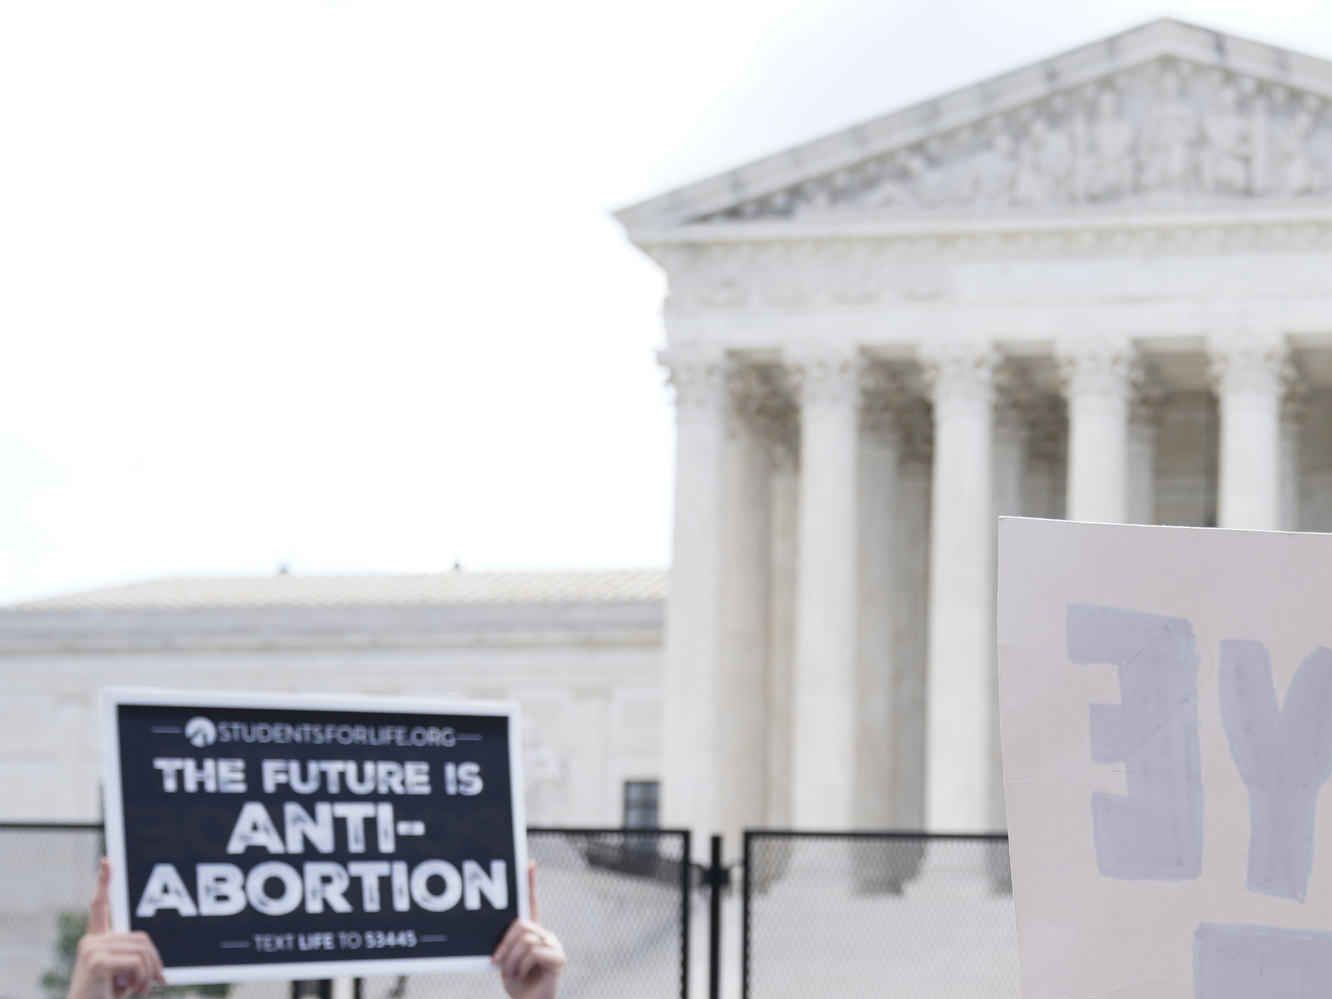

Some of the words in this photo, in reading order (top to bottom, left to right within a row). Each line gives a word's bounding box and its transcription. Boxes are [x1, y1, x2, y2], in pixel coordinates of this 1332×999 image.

[217, 720, 457, 747] STUDENTSFORLIFE.ORG
[153, 757, 247, 793] THE
[262, 758, 431, 795] FUTURE
[445, 761, 484, 796] IS
[226, 801, 426, 854] ANTI-
[135, 859, 510, 918] ABORTION
[253, 933, 295, 952] TEXT
[297, 932, 335, 950] LIFE
[338, 931, 363, 949] TO
[364, 929, 418, 948] 53445
